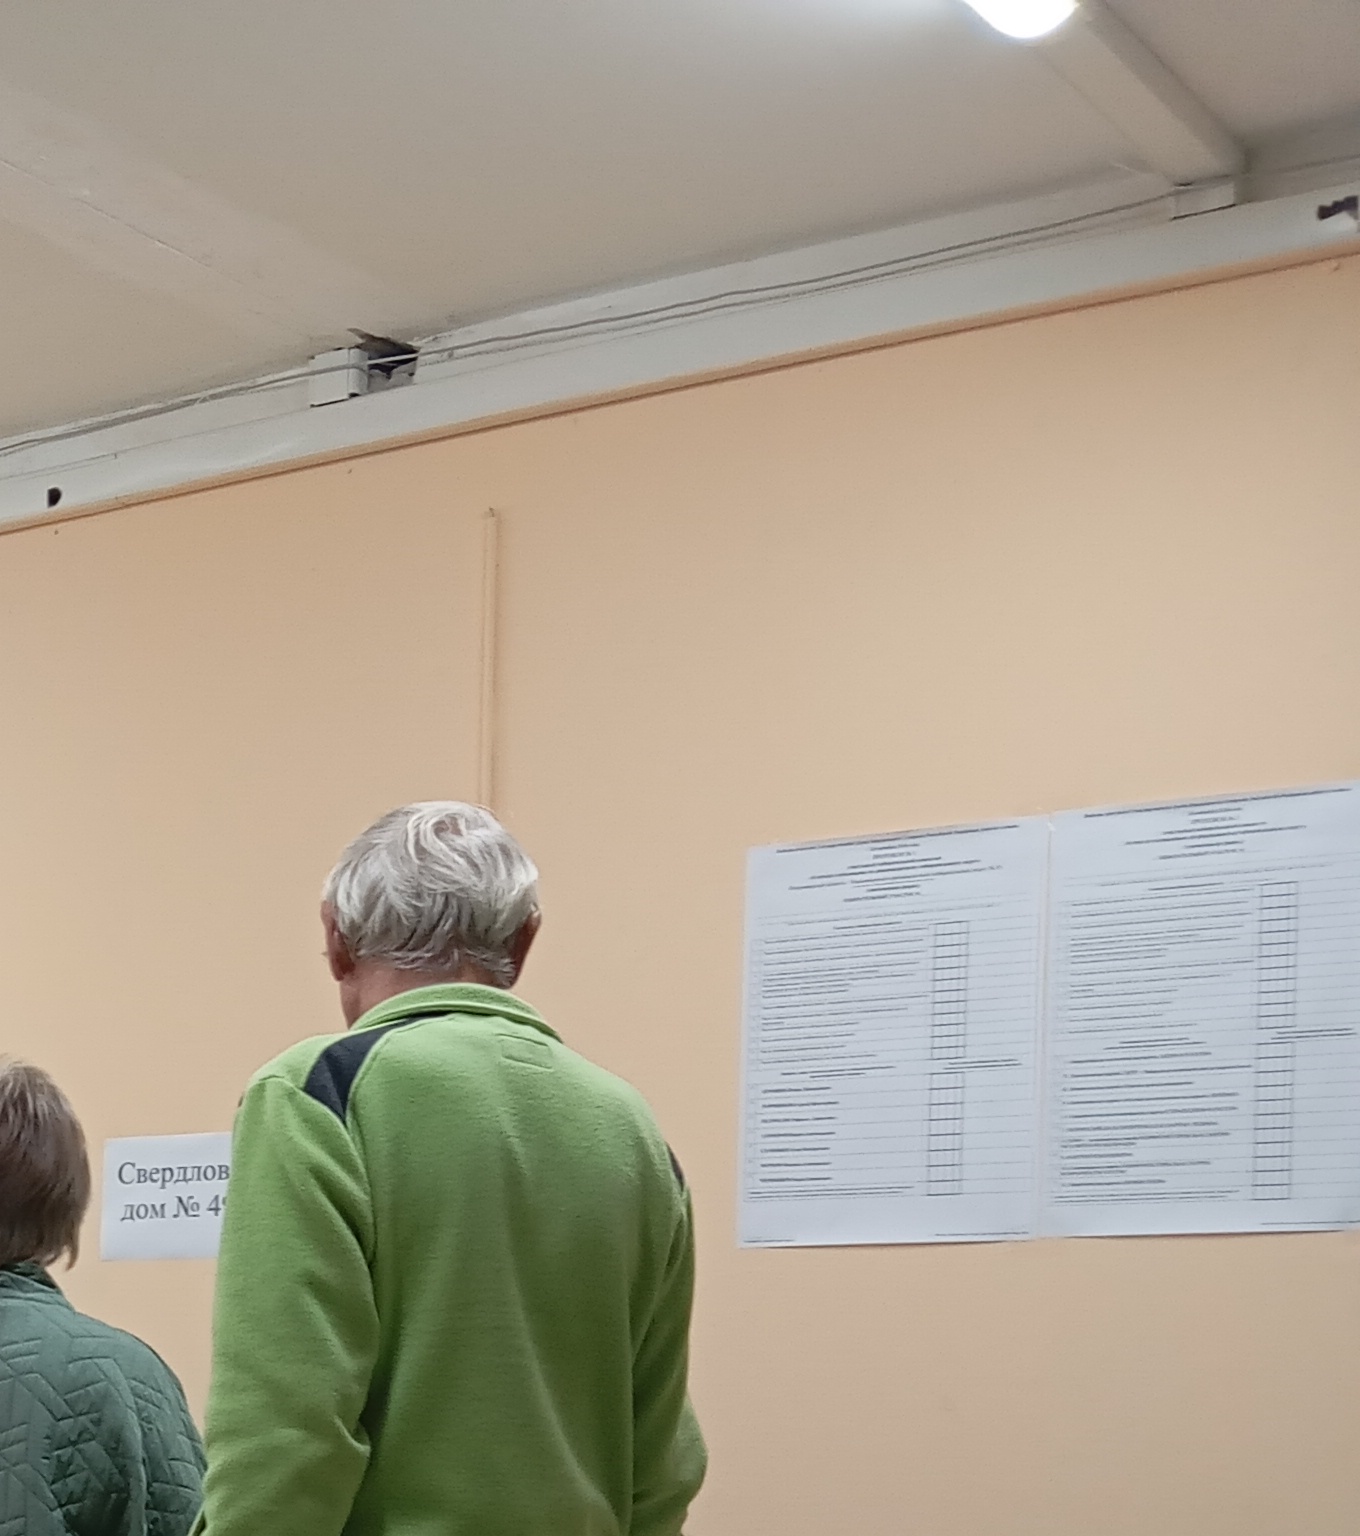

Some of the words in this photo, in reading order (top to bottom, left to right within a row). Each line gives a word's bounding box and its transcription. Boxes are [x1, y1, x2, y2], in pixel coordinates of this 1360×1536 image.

[118, 1161, 230, 1190] Свердлов
[120, 1203, 166, 1222] дом
[172, 1195, 201, 1219] №
